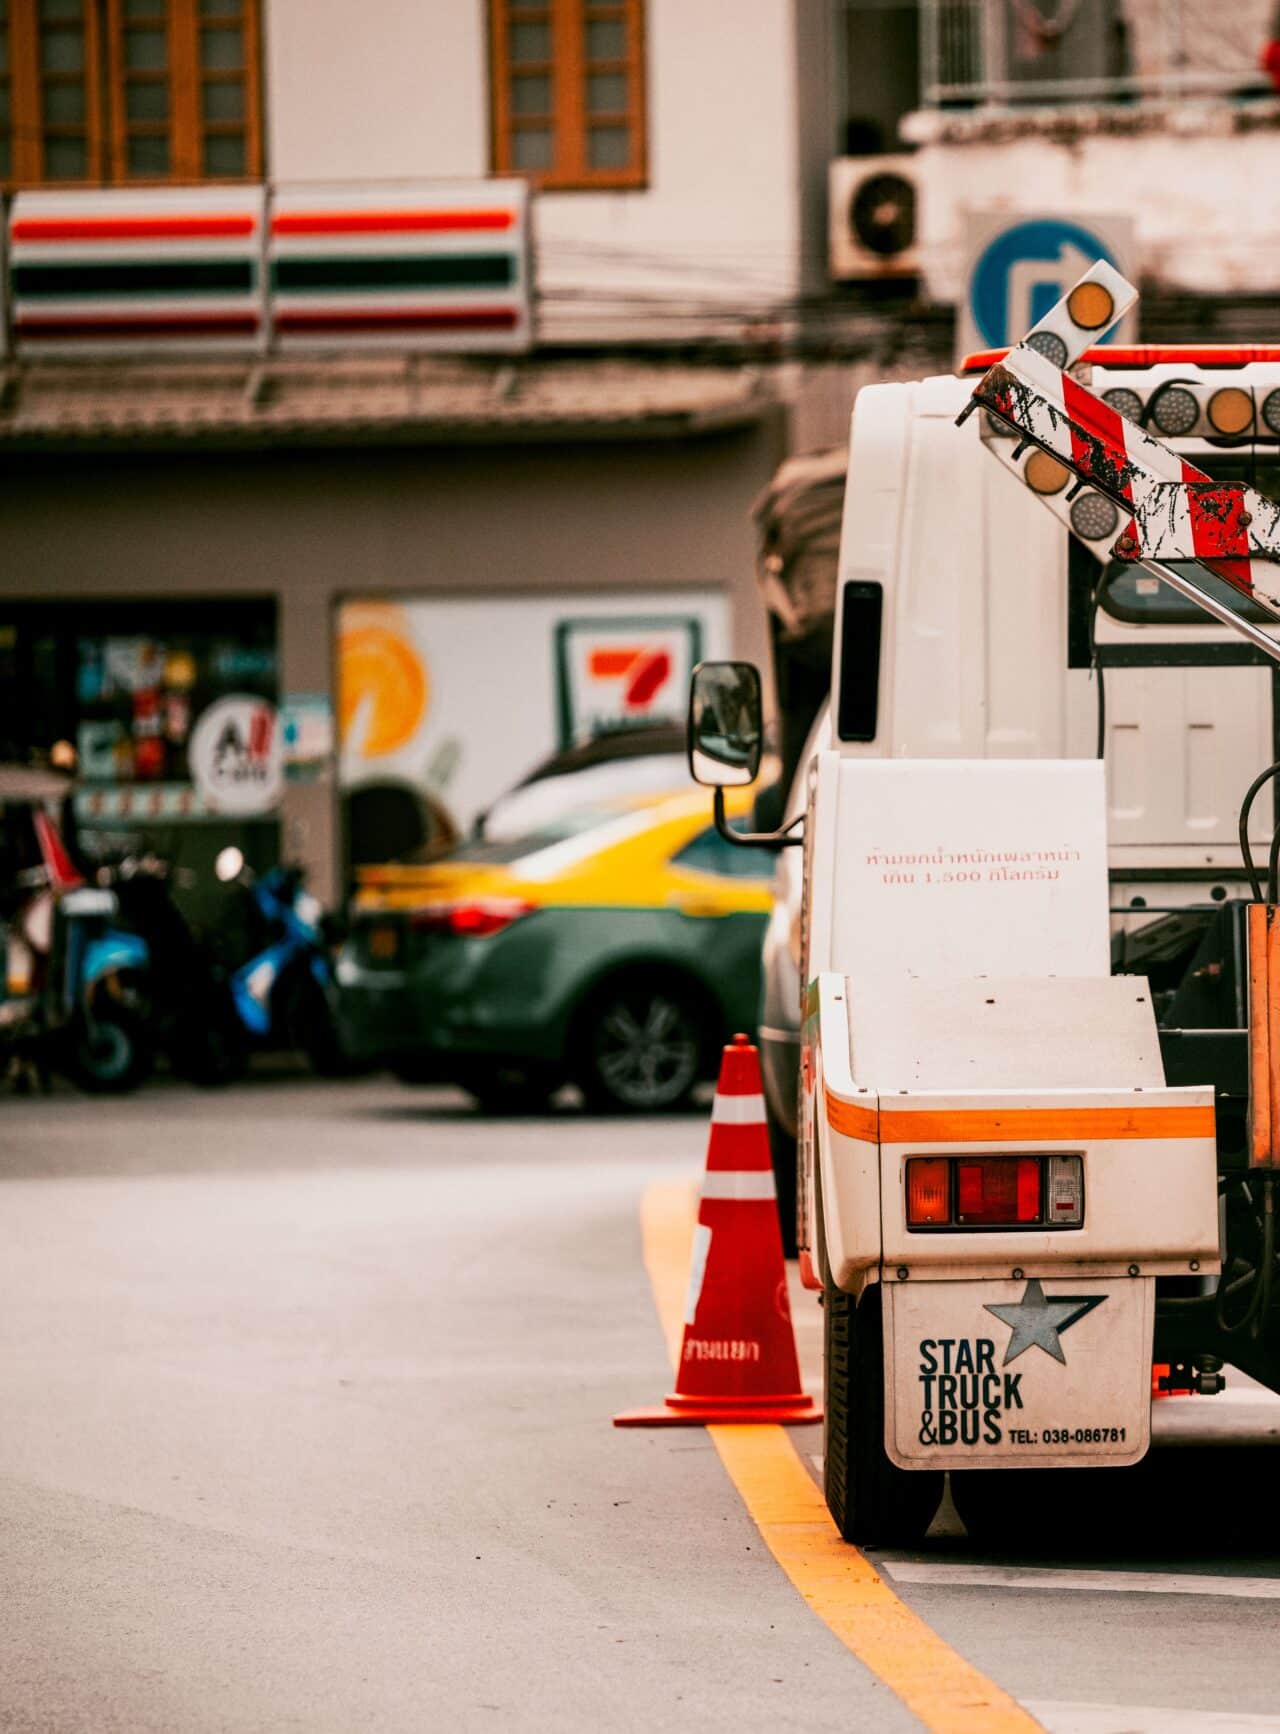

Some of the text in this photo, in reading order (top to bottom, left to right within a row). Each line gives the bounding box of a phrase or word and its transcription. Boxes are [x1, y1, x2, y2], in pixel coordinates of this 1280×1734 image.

[918, 1338, 996, 1375] STAR
[918, 1373, 1025, 1410] TRUCK
[918, 1409, 1002, 1446] &BUS
[1008, 1427, 1126, 1445] TEL: 038-086781
